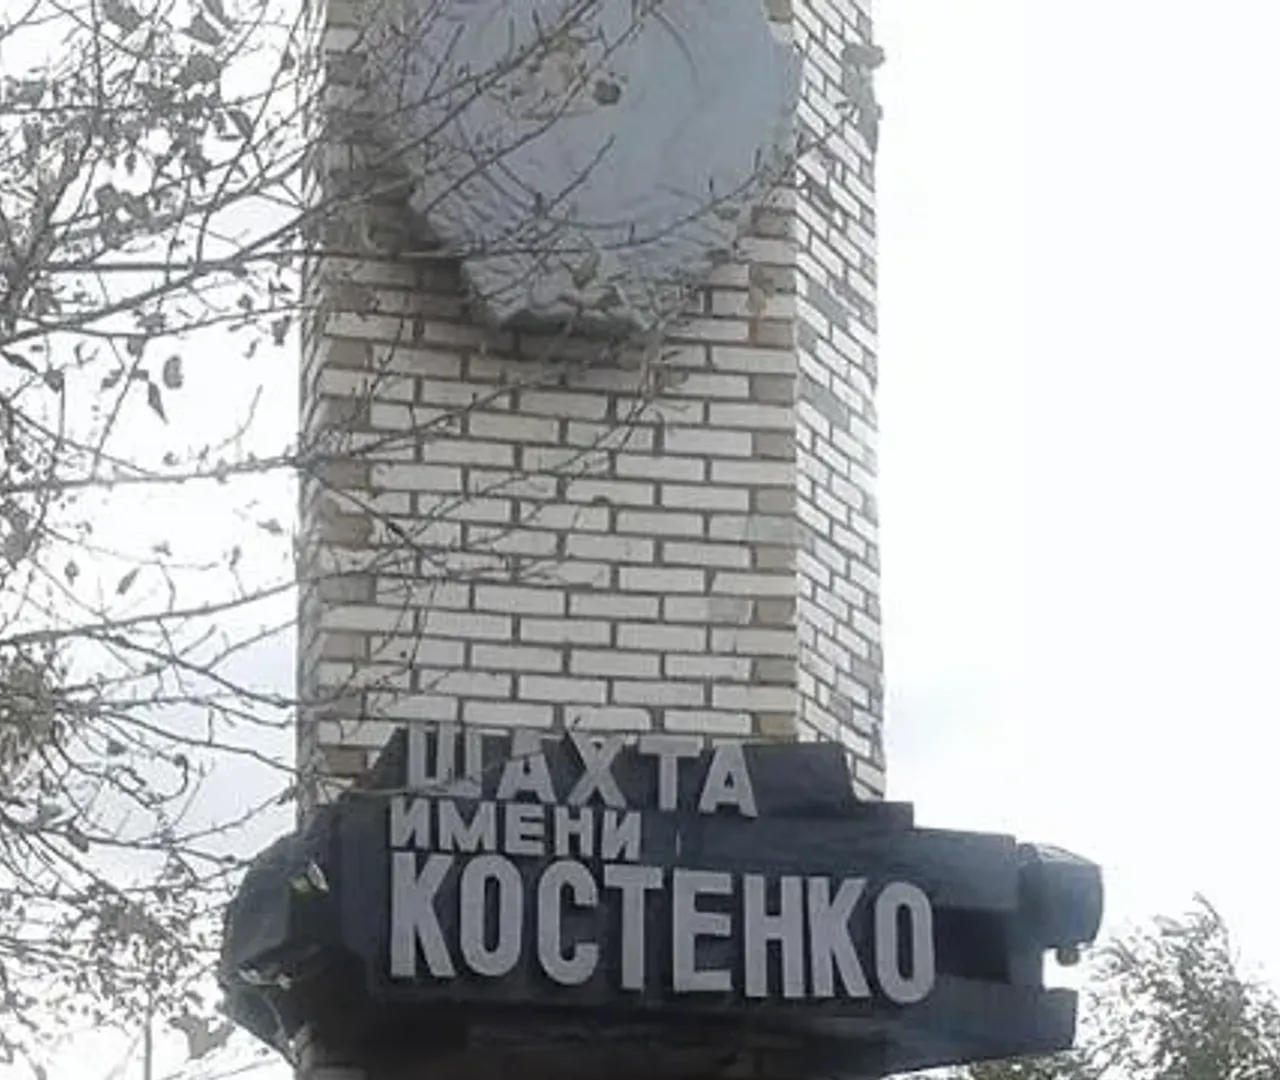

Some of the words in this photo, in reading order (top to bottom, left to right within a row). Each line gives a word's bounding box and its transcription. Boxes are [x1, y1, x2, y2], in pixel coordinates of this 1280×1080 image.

[407, 721, 759, 819] ШАХТА
[389, 799, 643, 862] ИМЕНИ
[388, 853, 937, 1004] КОСТЕНКО
